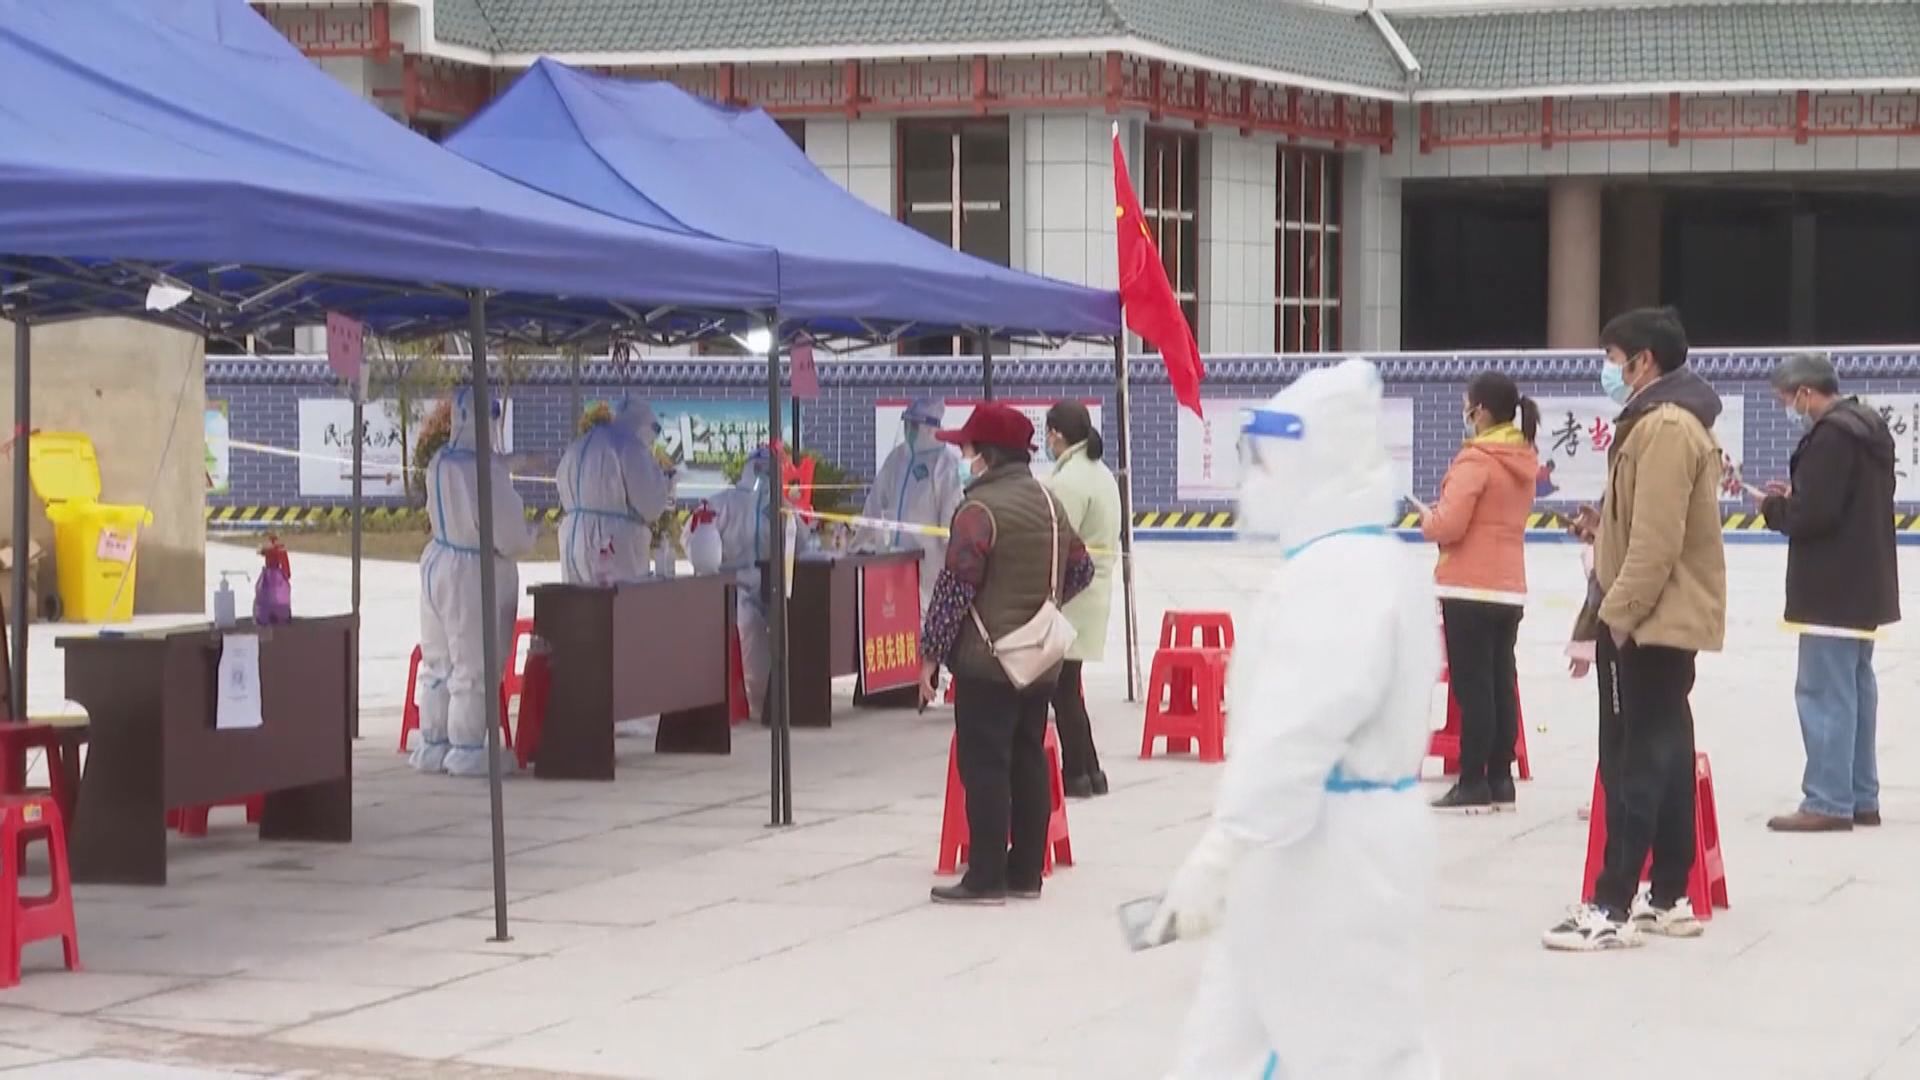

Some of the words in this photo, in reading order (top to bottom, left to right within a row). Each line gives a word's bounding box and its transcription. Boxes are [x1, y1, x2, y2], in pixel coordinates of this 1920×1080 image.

[865, 631, 916, 673] 党员先锋岗
